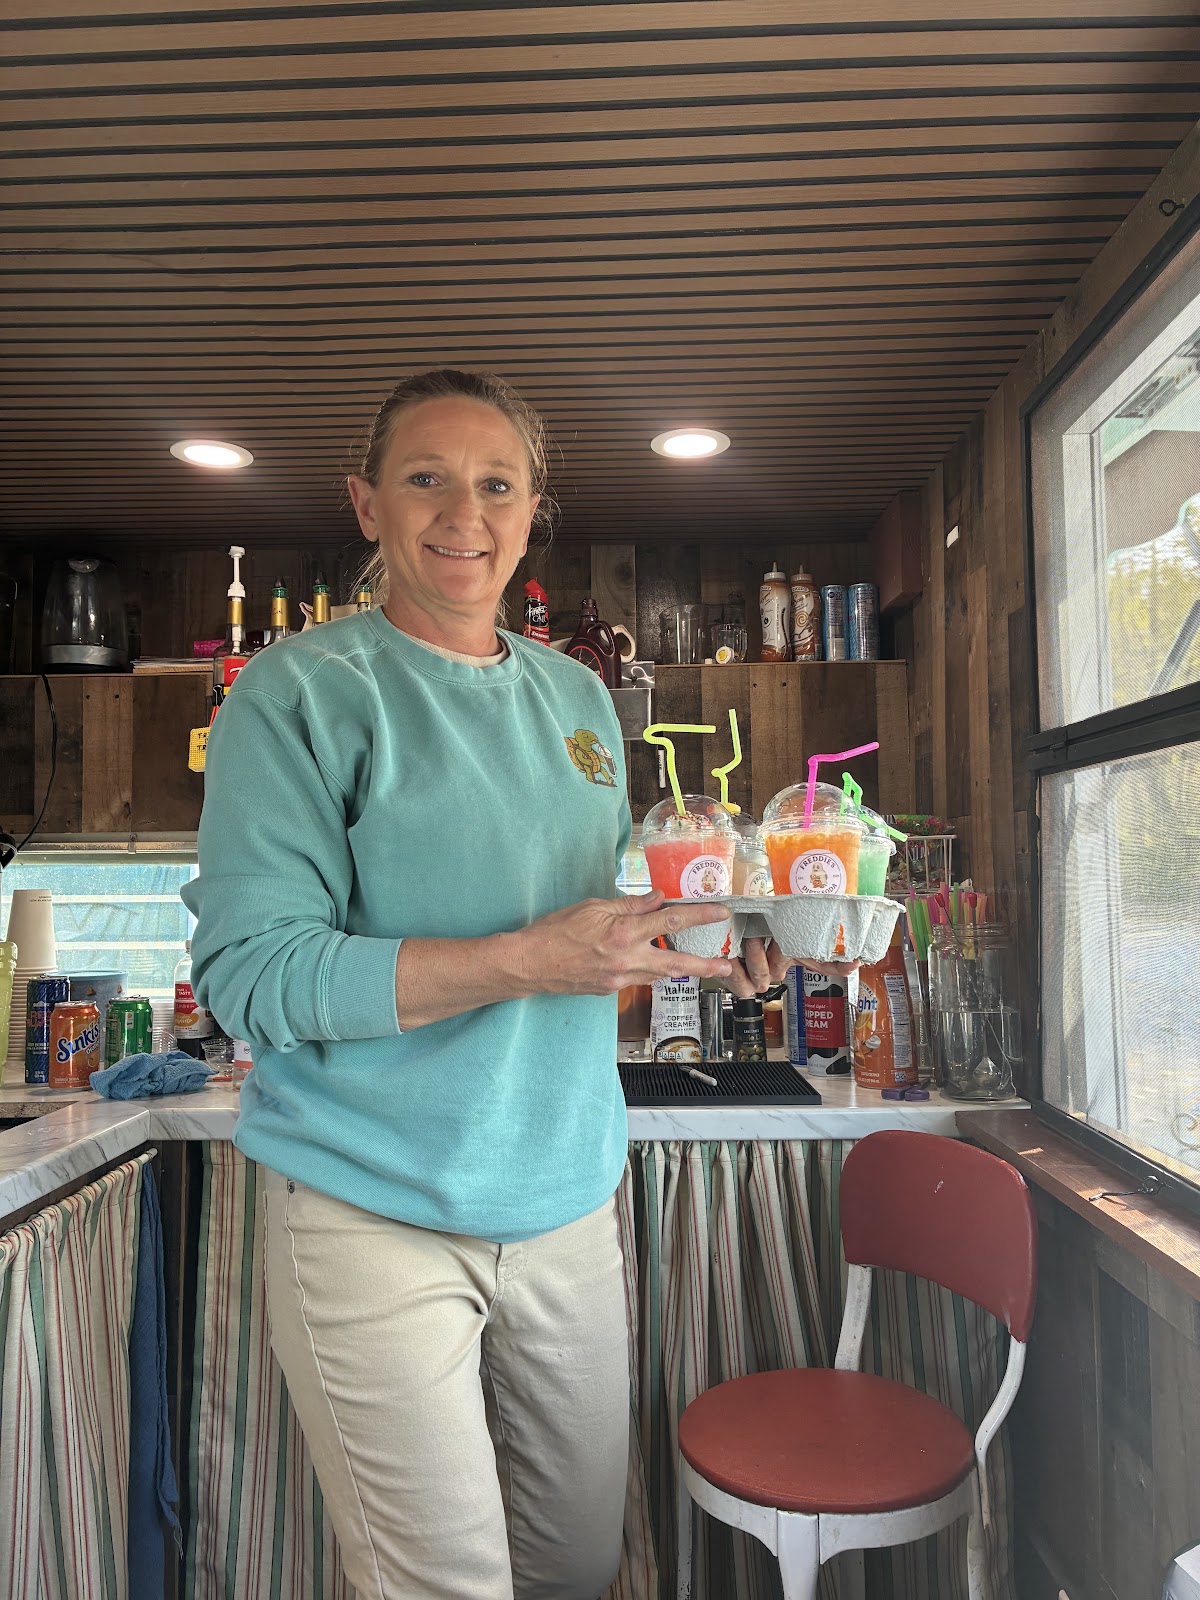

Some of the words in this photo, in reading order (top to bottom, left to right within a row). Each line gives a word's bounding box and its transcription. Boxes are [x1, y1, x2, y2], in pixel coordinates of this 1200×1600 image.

[664, 984, 695, 996] Italian
[804, 1019, 829, 1029] REAM
[56, 1022, 99, 1062] Sunkis
